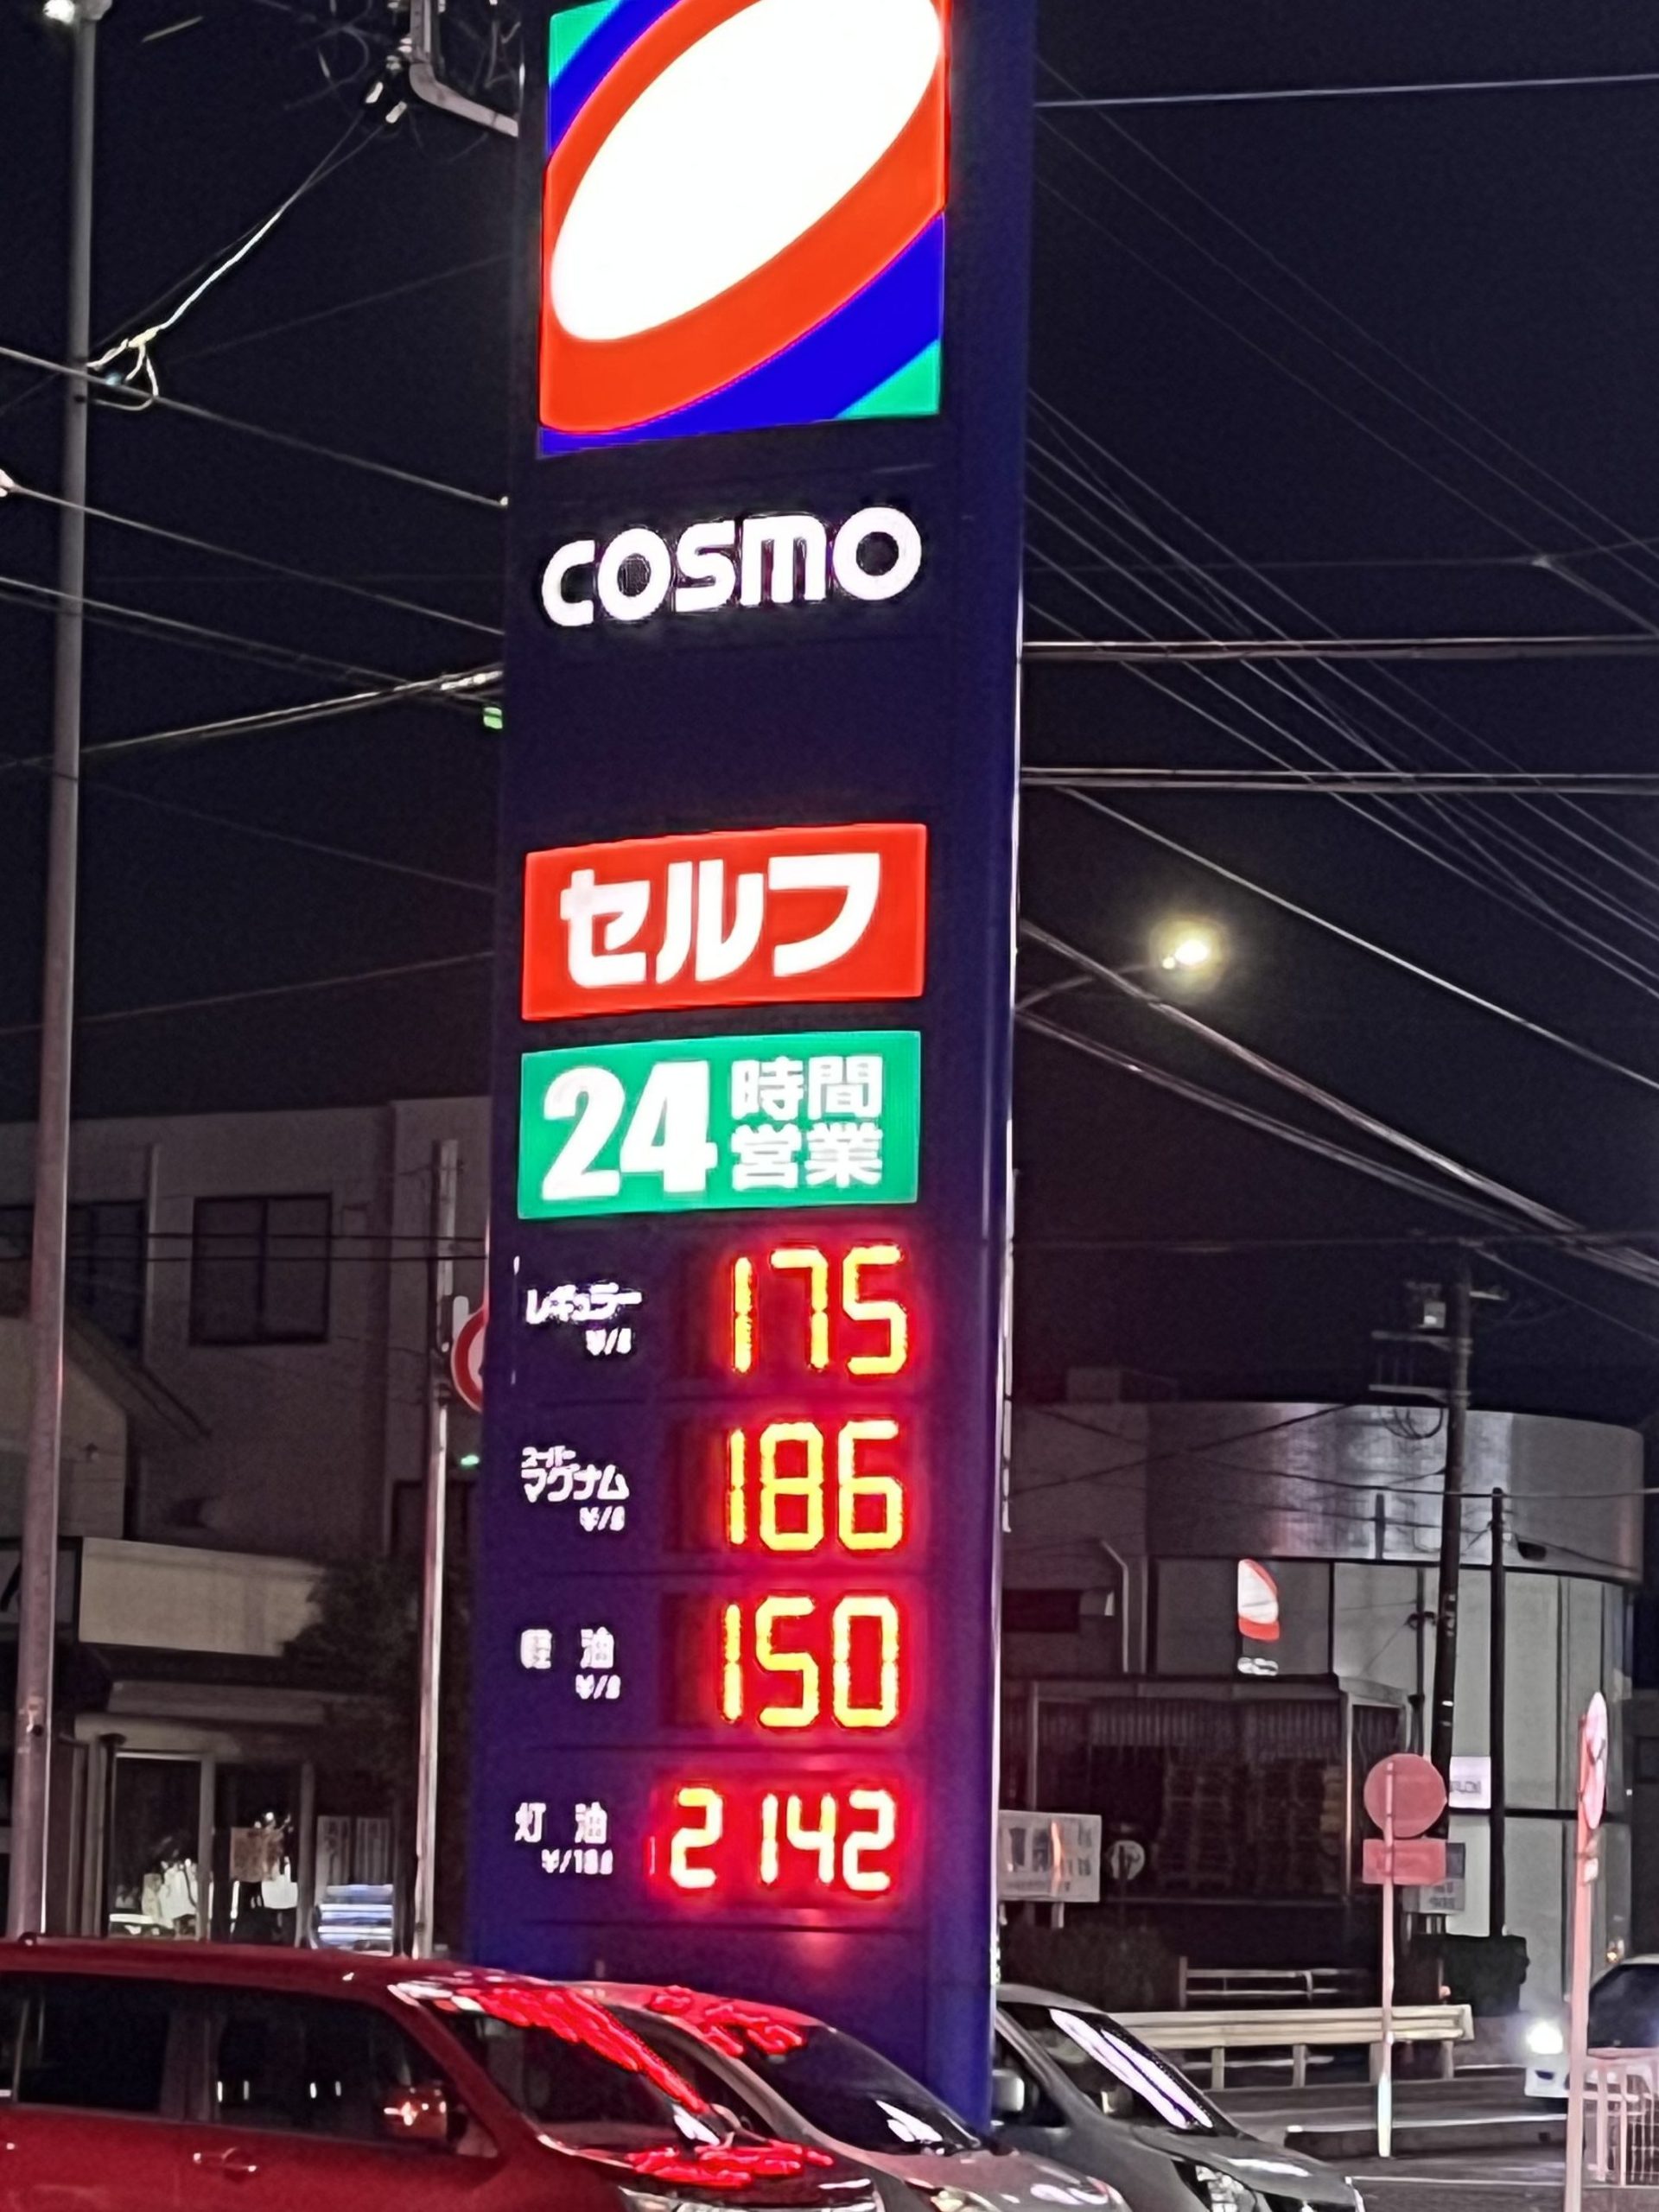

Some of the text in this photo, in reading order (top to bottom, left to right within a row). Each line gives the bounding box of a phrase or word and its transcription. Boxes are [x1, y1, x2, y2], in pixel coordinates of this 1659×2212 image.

[541, 506, 922, 626] COSMO
[559, 853, 880, 988] セルフ
[542, 1059, 718, 1201] 24
[730, 1122, 883, 1192] 営業
[734, 1244, 907, 1375] 175
[521, 1464, 630, 1503] マグナム
[729, 1420, 903, 1550] 186
[723, 1596, 899, 1727] 150
